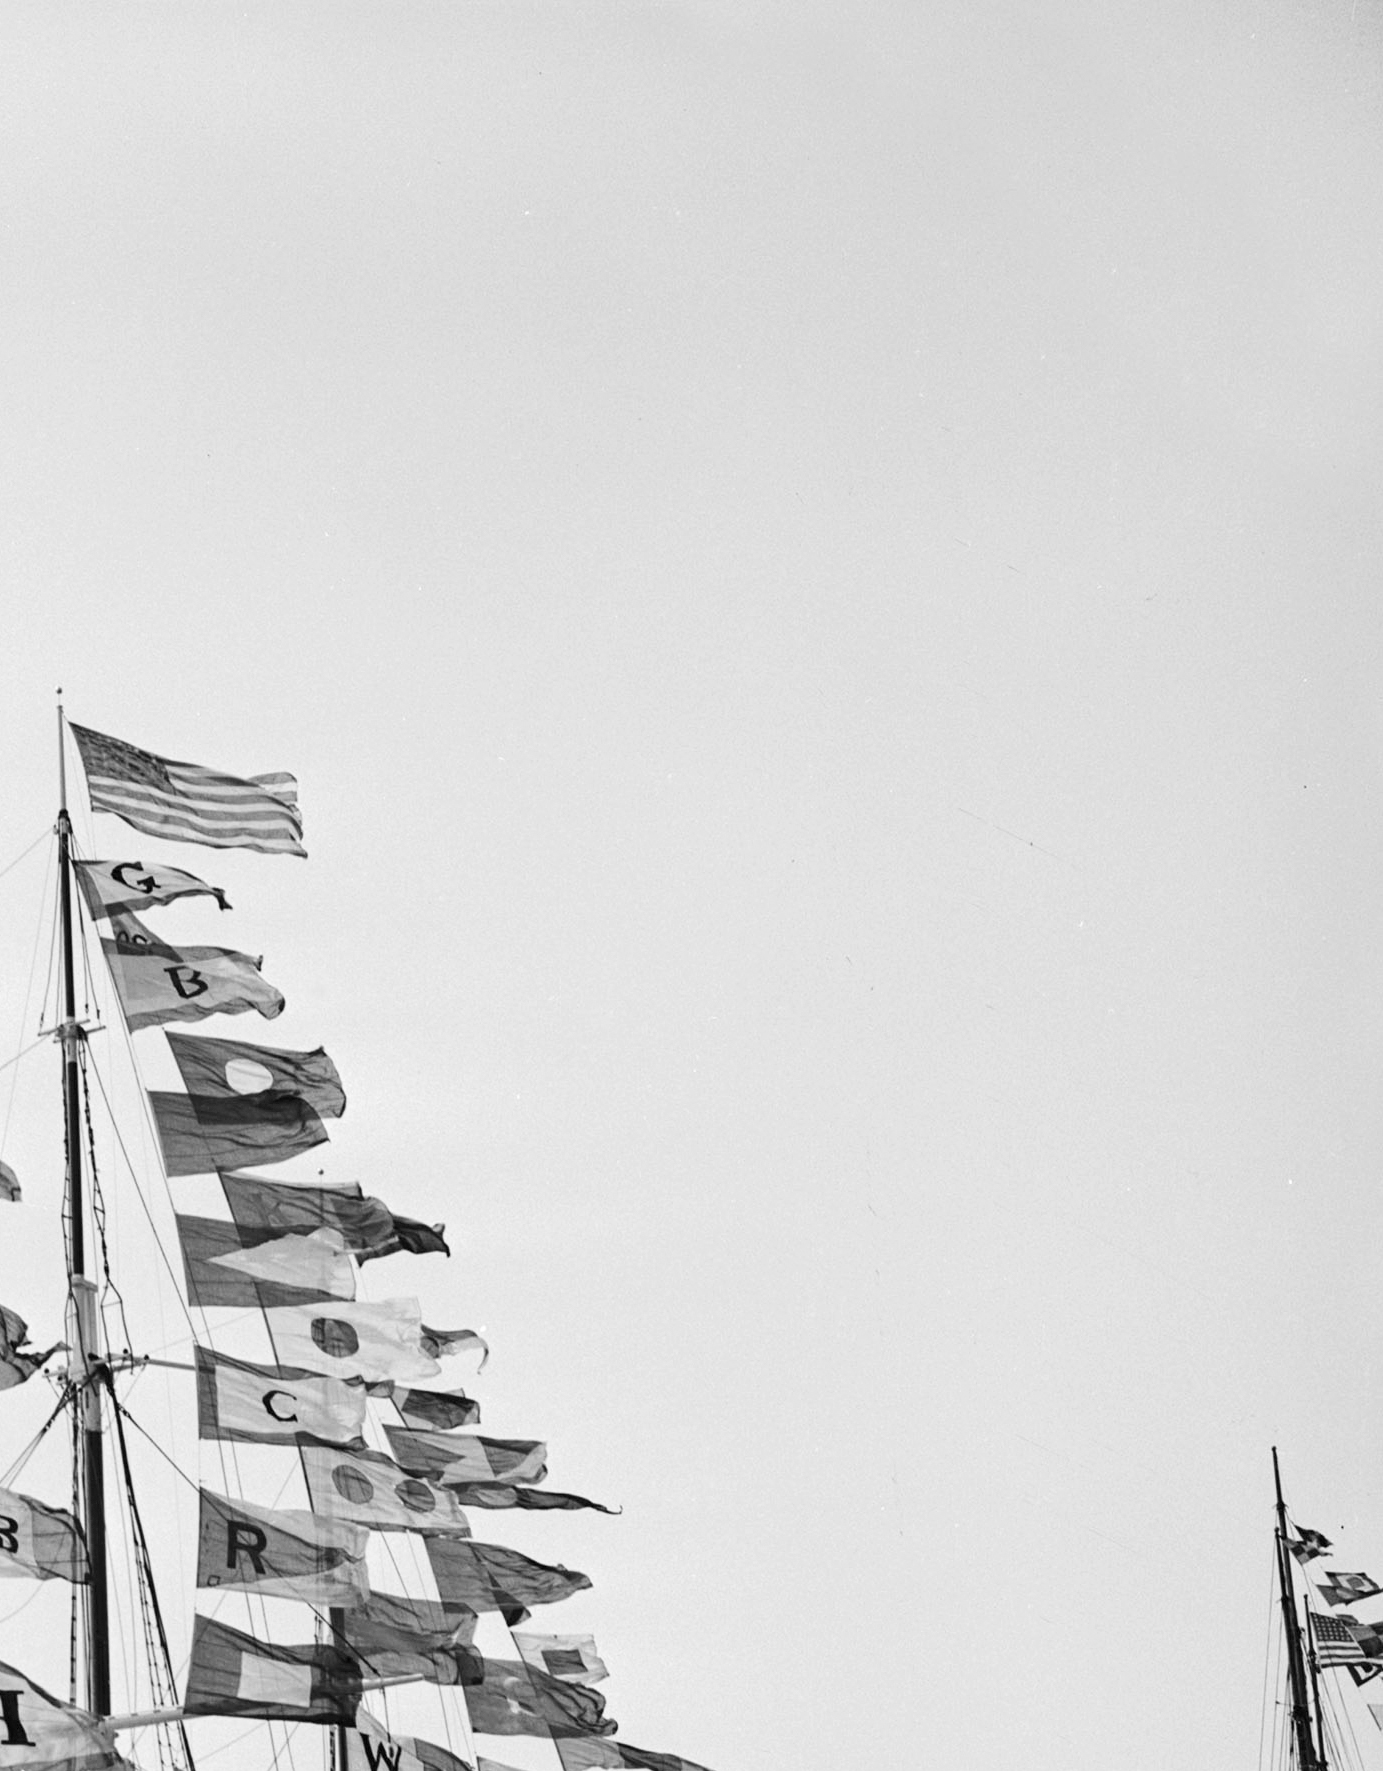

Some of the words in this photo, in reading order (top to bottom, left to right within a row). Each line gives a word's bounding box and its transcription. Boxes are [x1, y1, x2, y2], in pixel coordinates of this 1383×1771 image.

[111, 862, 160, 894] G
[164, 965, 208, 999] B
[263, 1390, 298, 1423] C
[226, 1519, 267, 1575] R
